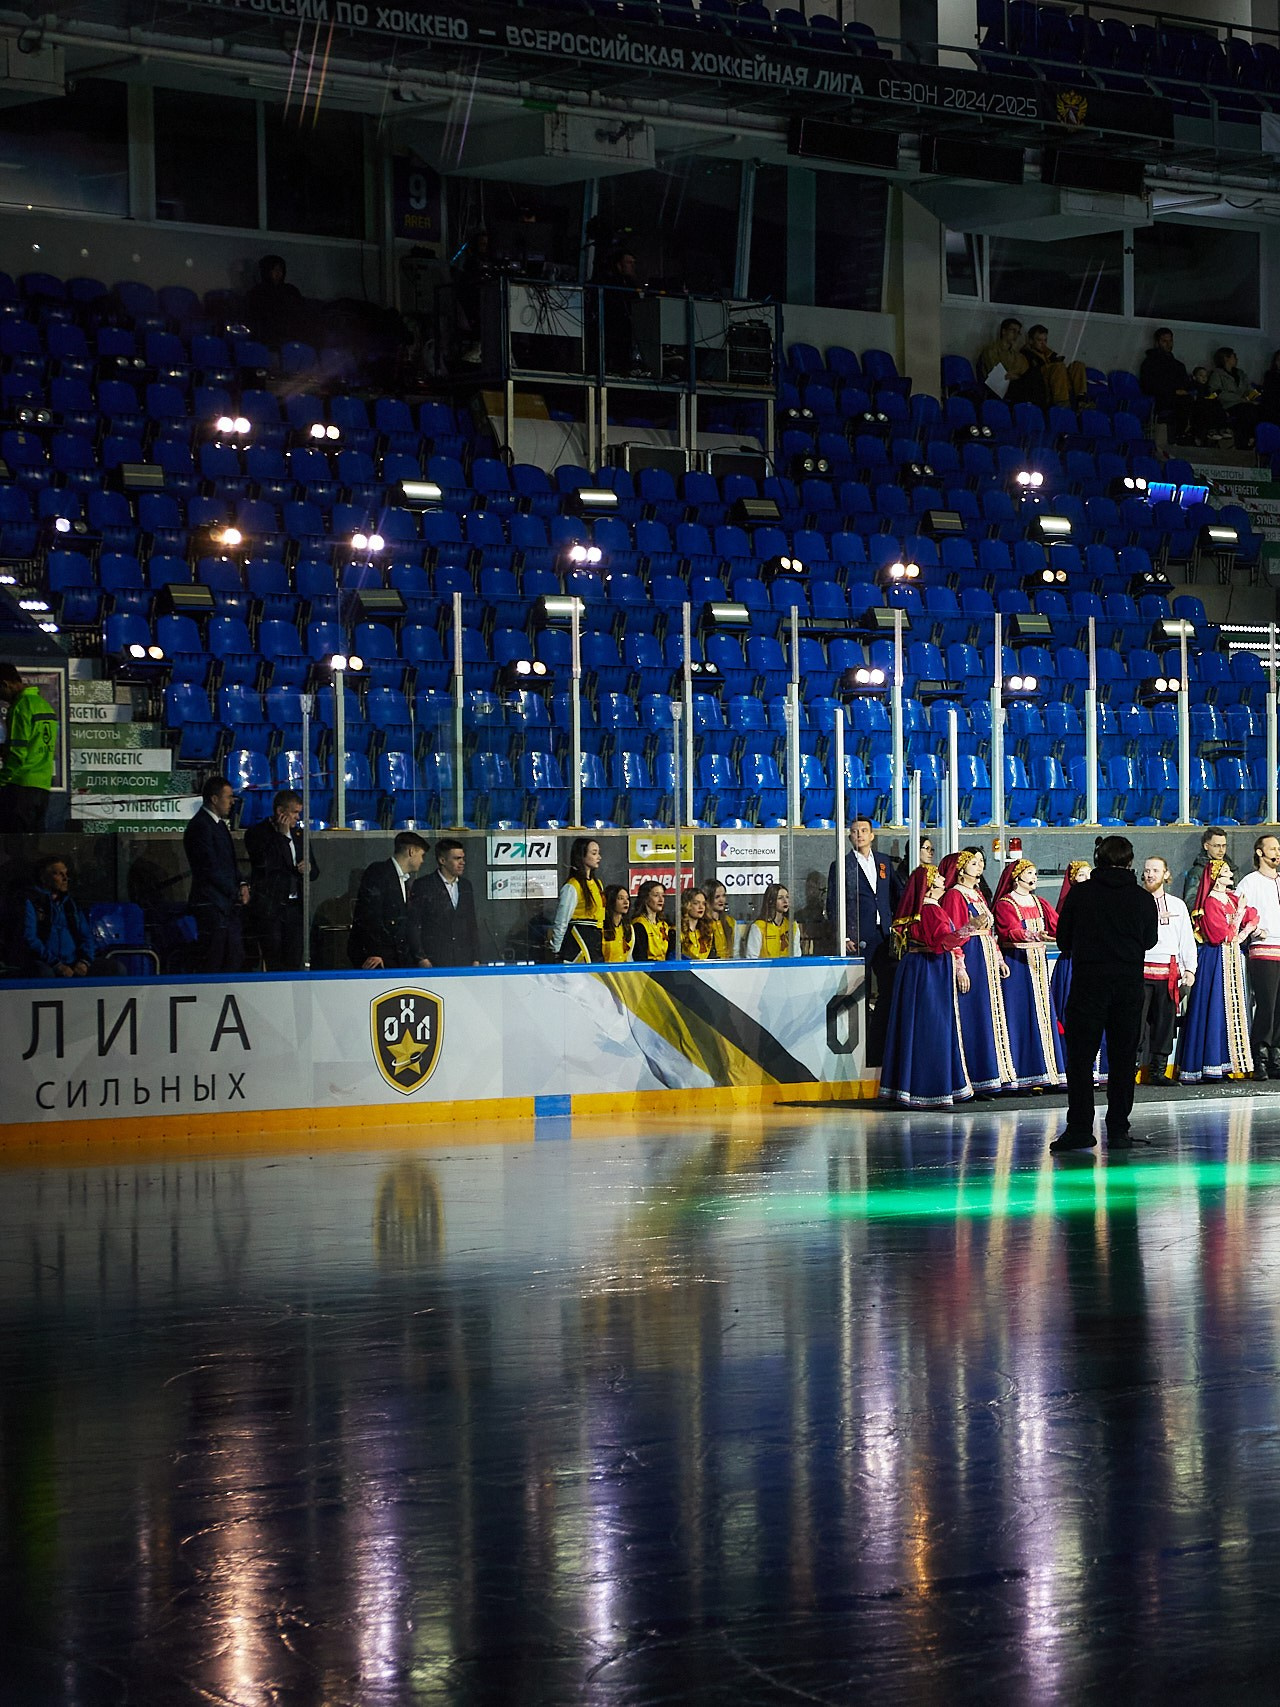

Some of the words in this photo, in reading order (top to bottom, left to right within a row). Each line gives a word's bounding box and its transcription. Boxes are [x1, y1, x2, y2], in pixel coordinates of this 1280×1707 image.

[335, 4, 369, 26] ПО
[376, 6, 469, 40] ХОККЕЮ
[505, 24, 685, 70] ВСЕРОССИЙСКАЯ
[690, 49, 809, 87] ХОККЕЙНАЯ
[813, 72, 865, 95] ЛИГА
[877, 78, 938, 106] СЕЗОН
[942, 86, 1038, 118] 2024/2025
[408, 173, 427, 210] 9
[71, 730, 120, 740] ЧИСТОТЫ
[80, 752, 143, 765] SYNERGETIC
[86, 776, 108, 788] ДЛЯ
[110, 776, 159, 787] КРАСОТЫ
[119, 800, 182, 813] SYNERGETIC
[730, 846, 776, 856] Ростелеком
[22, 994, 252, 1061] ЛИГА
[35, 1072, 246, 1110] СИЛЬНЫХ
